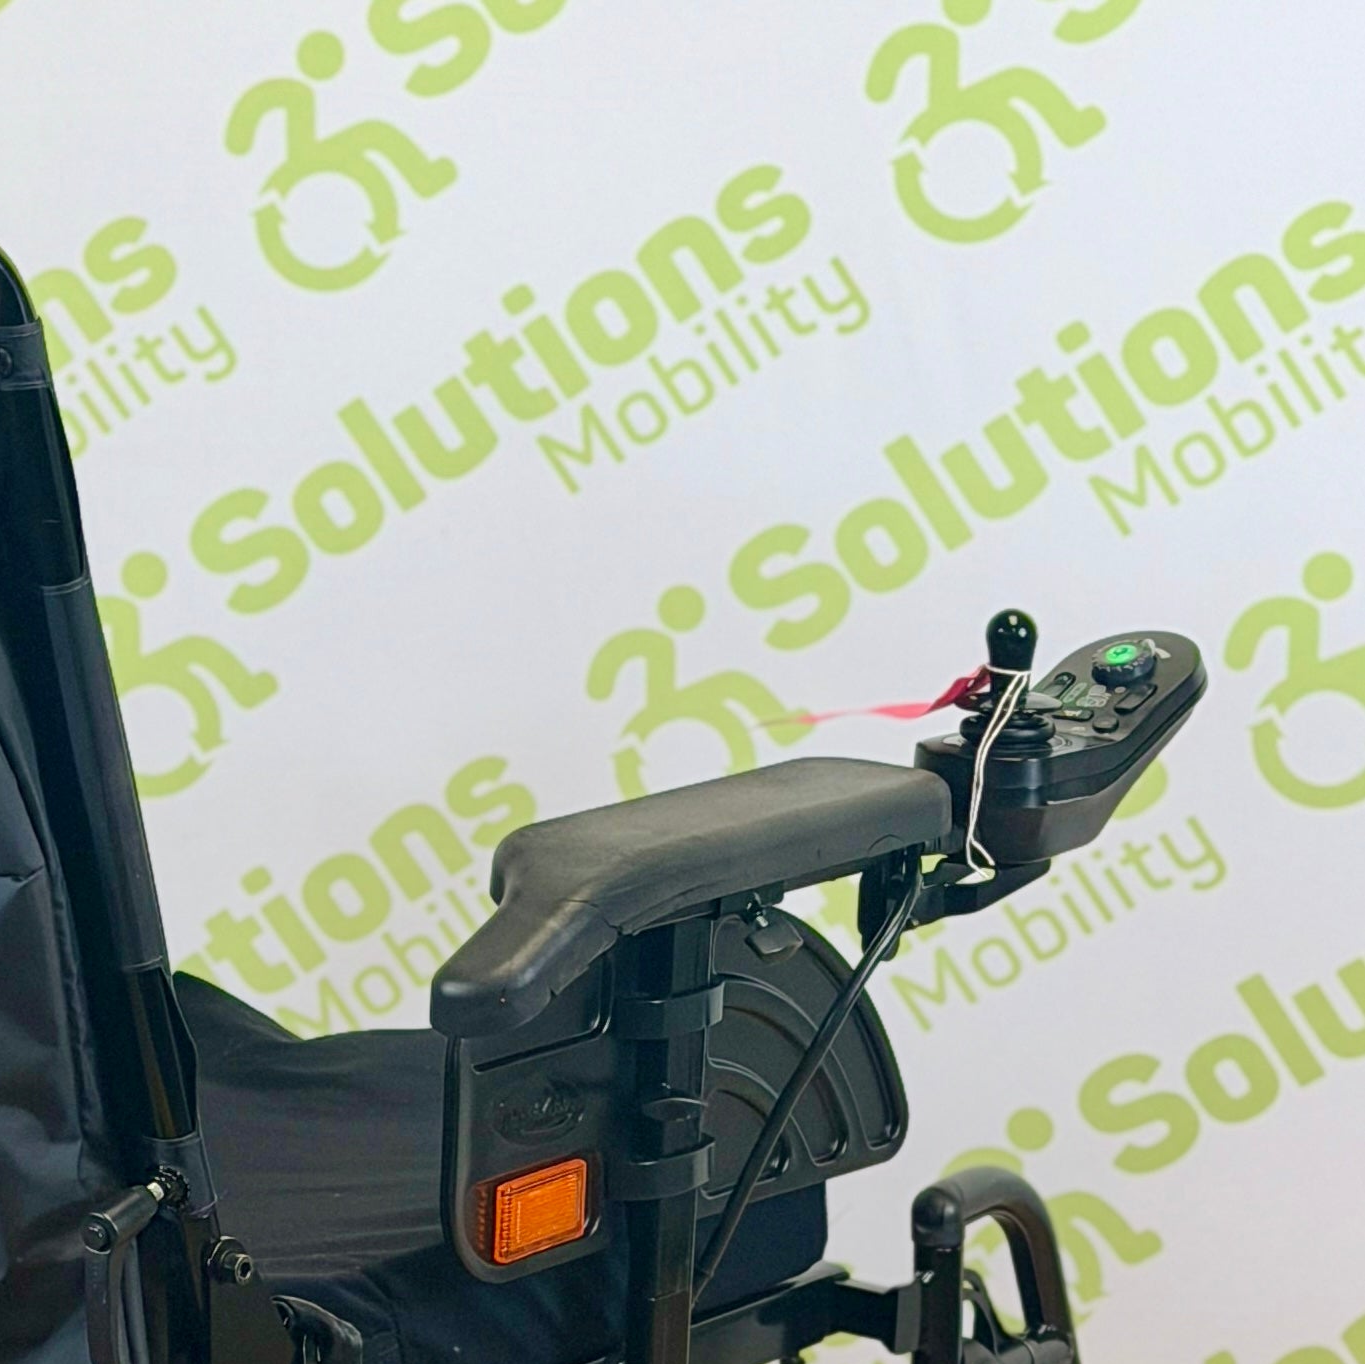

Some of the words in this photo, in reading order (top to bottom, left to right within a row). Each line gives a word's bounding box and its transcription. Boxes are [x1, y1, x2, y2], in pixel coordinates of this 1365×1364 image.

[188, 163, 813, 616] Solutions
[535, 257, 871, 495] Mobility
[727, 199, 1365, 653] Solutions
[174, 755, 538, 996] tions
[275, 875, 496, 1042] Mobil
[890, 817, 1228, 1033] Mobility
